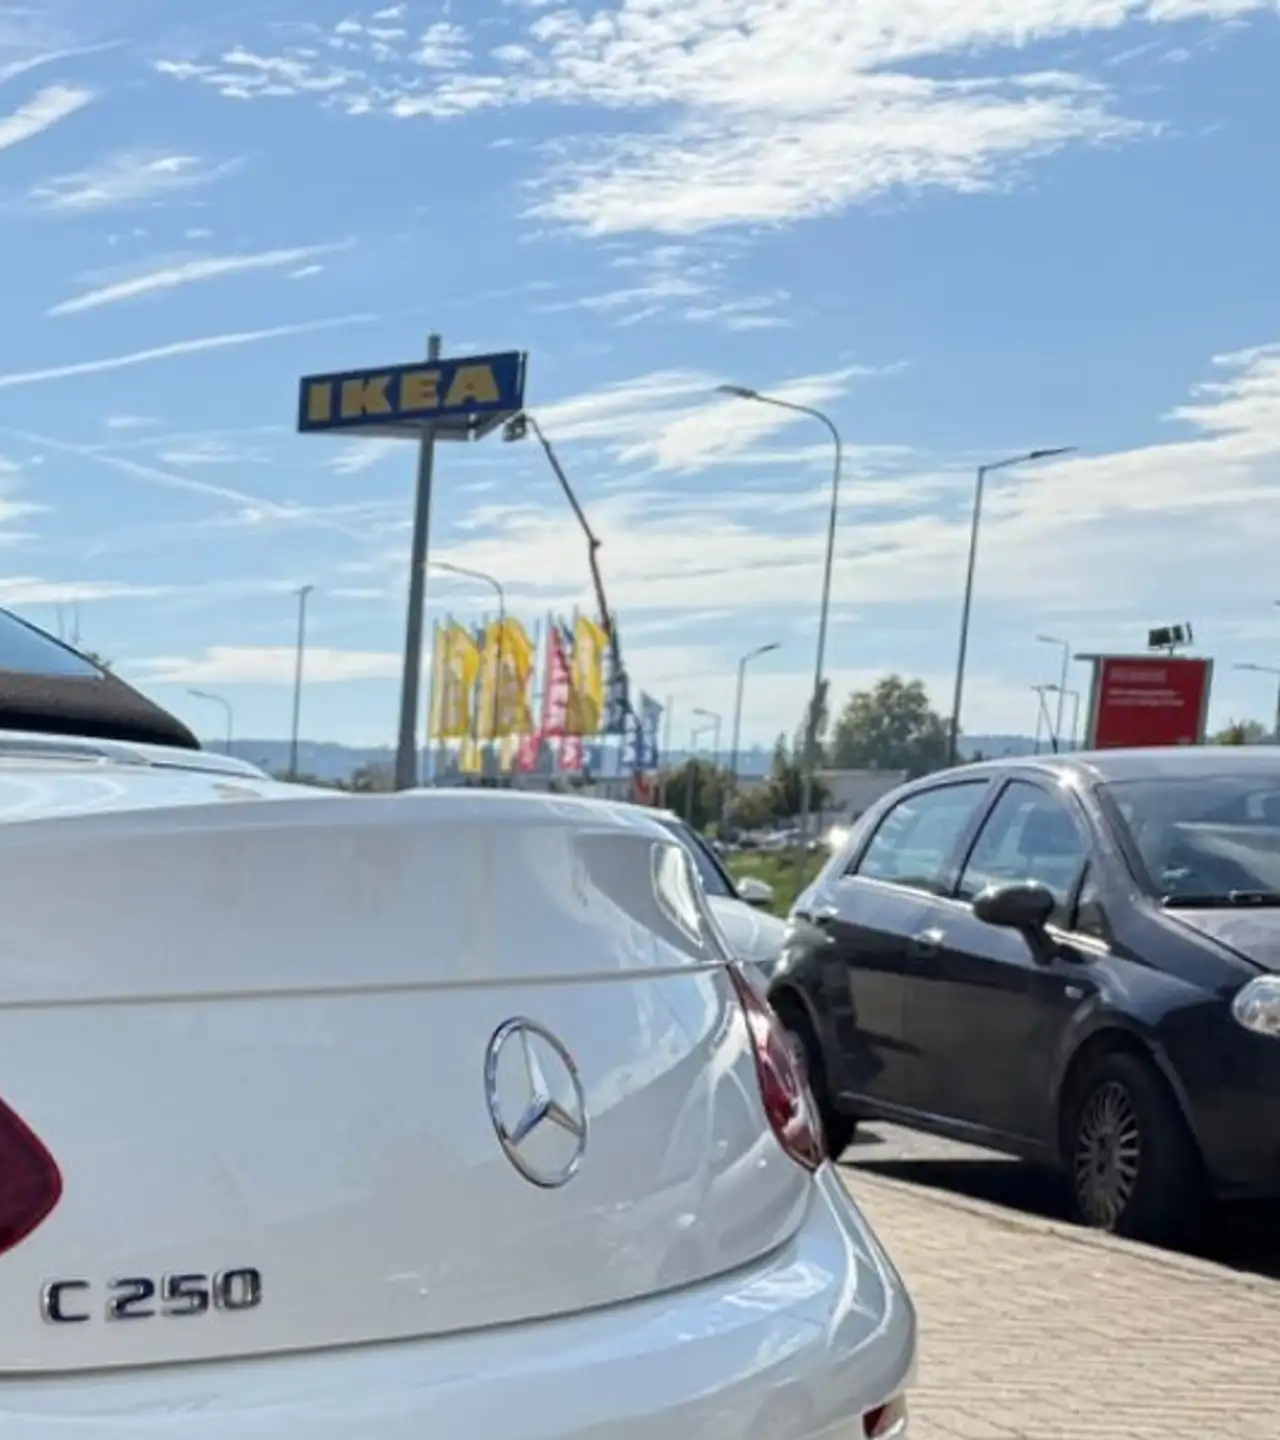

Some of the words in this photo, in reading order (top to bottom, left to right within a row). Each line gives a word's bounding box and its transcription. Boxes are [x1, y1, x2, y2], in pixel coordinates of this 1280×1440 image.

[307, 363, 501, 422] IKEA
[40, 1278, 91, 1325] C
[104, 1266, 263, 1324] 250
